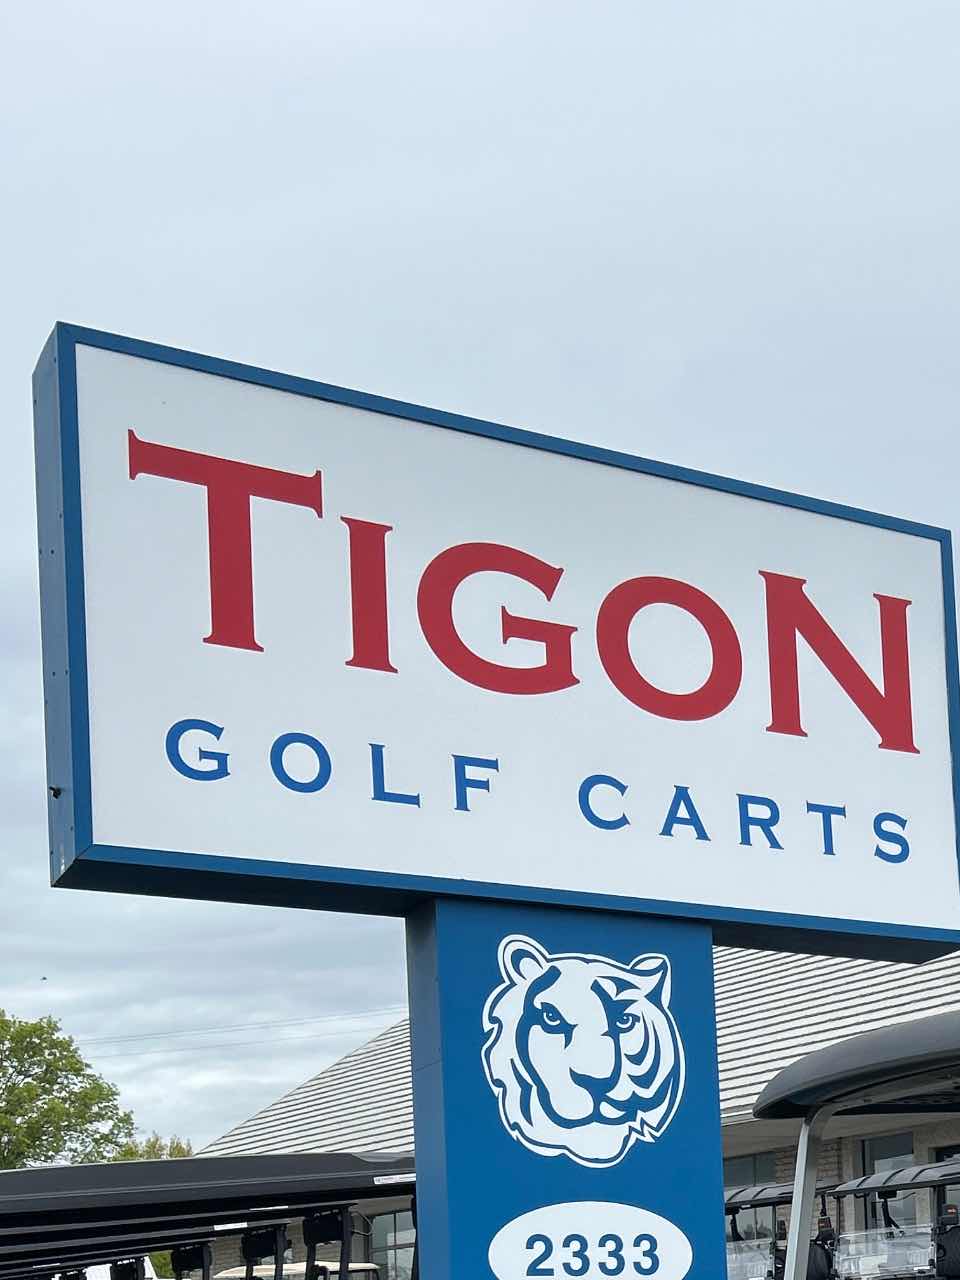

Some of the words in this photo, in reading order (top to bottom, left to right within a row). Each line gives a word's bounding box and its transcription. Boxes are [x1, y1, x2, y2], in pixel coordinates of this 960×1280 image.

[128, 430, 921, 754] TIGON
[164, 718, 500, 812] GOLF
[577, 774, 912, 865] CARTS
[525, 1232, 661, 1278] 2333
